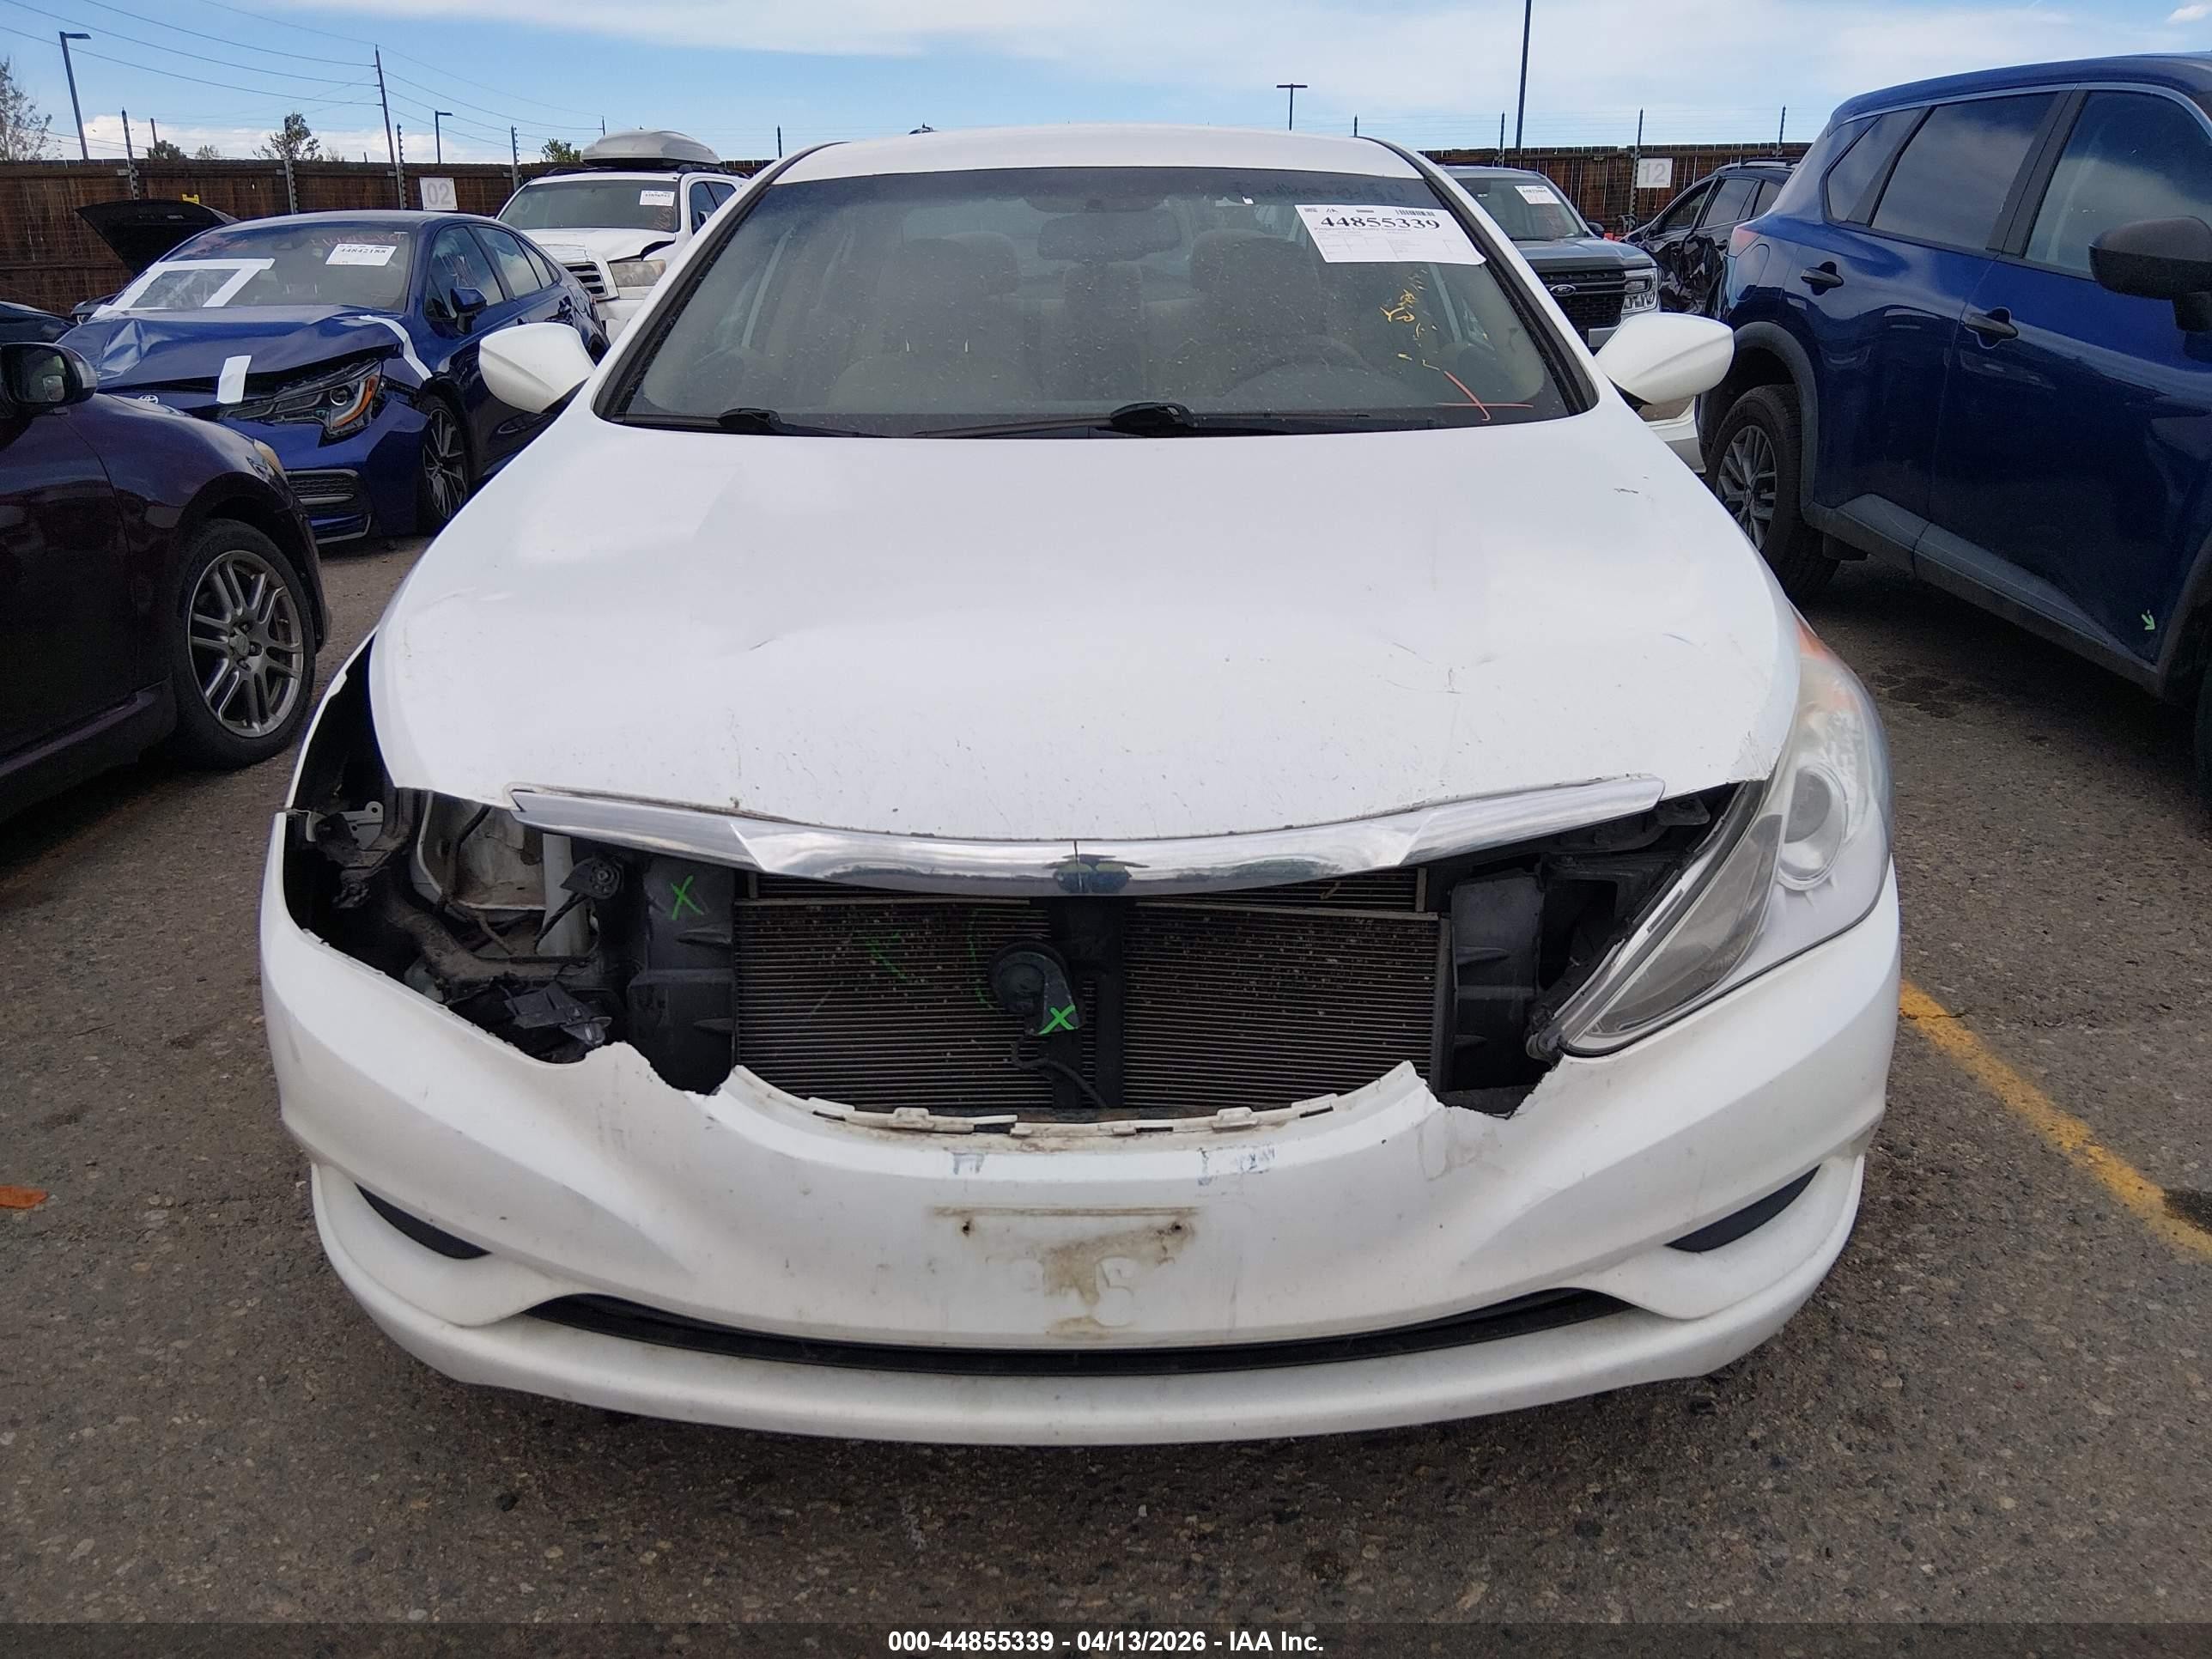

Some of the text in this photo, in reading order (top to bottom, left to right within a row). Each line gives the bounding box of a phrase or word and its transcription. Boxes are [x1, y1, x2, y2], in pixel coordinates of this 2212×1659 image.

[1642, 162, 1666, 183] 12
[427, 182, 453, 205] 02
[1321, 216, 1440, 230] 44855339
